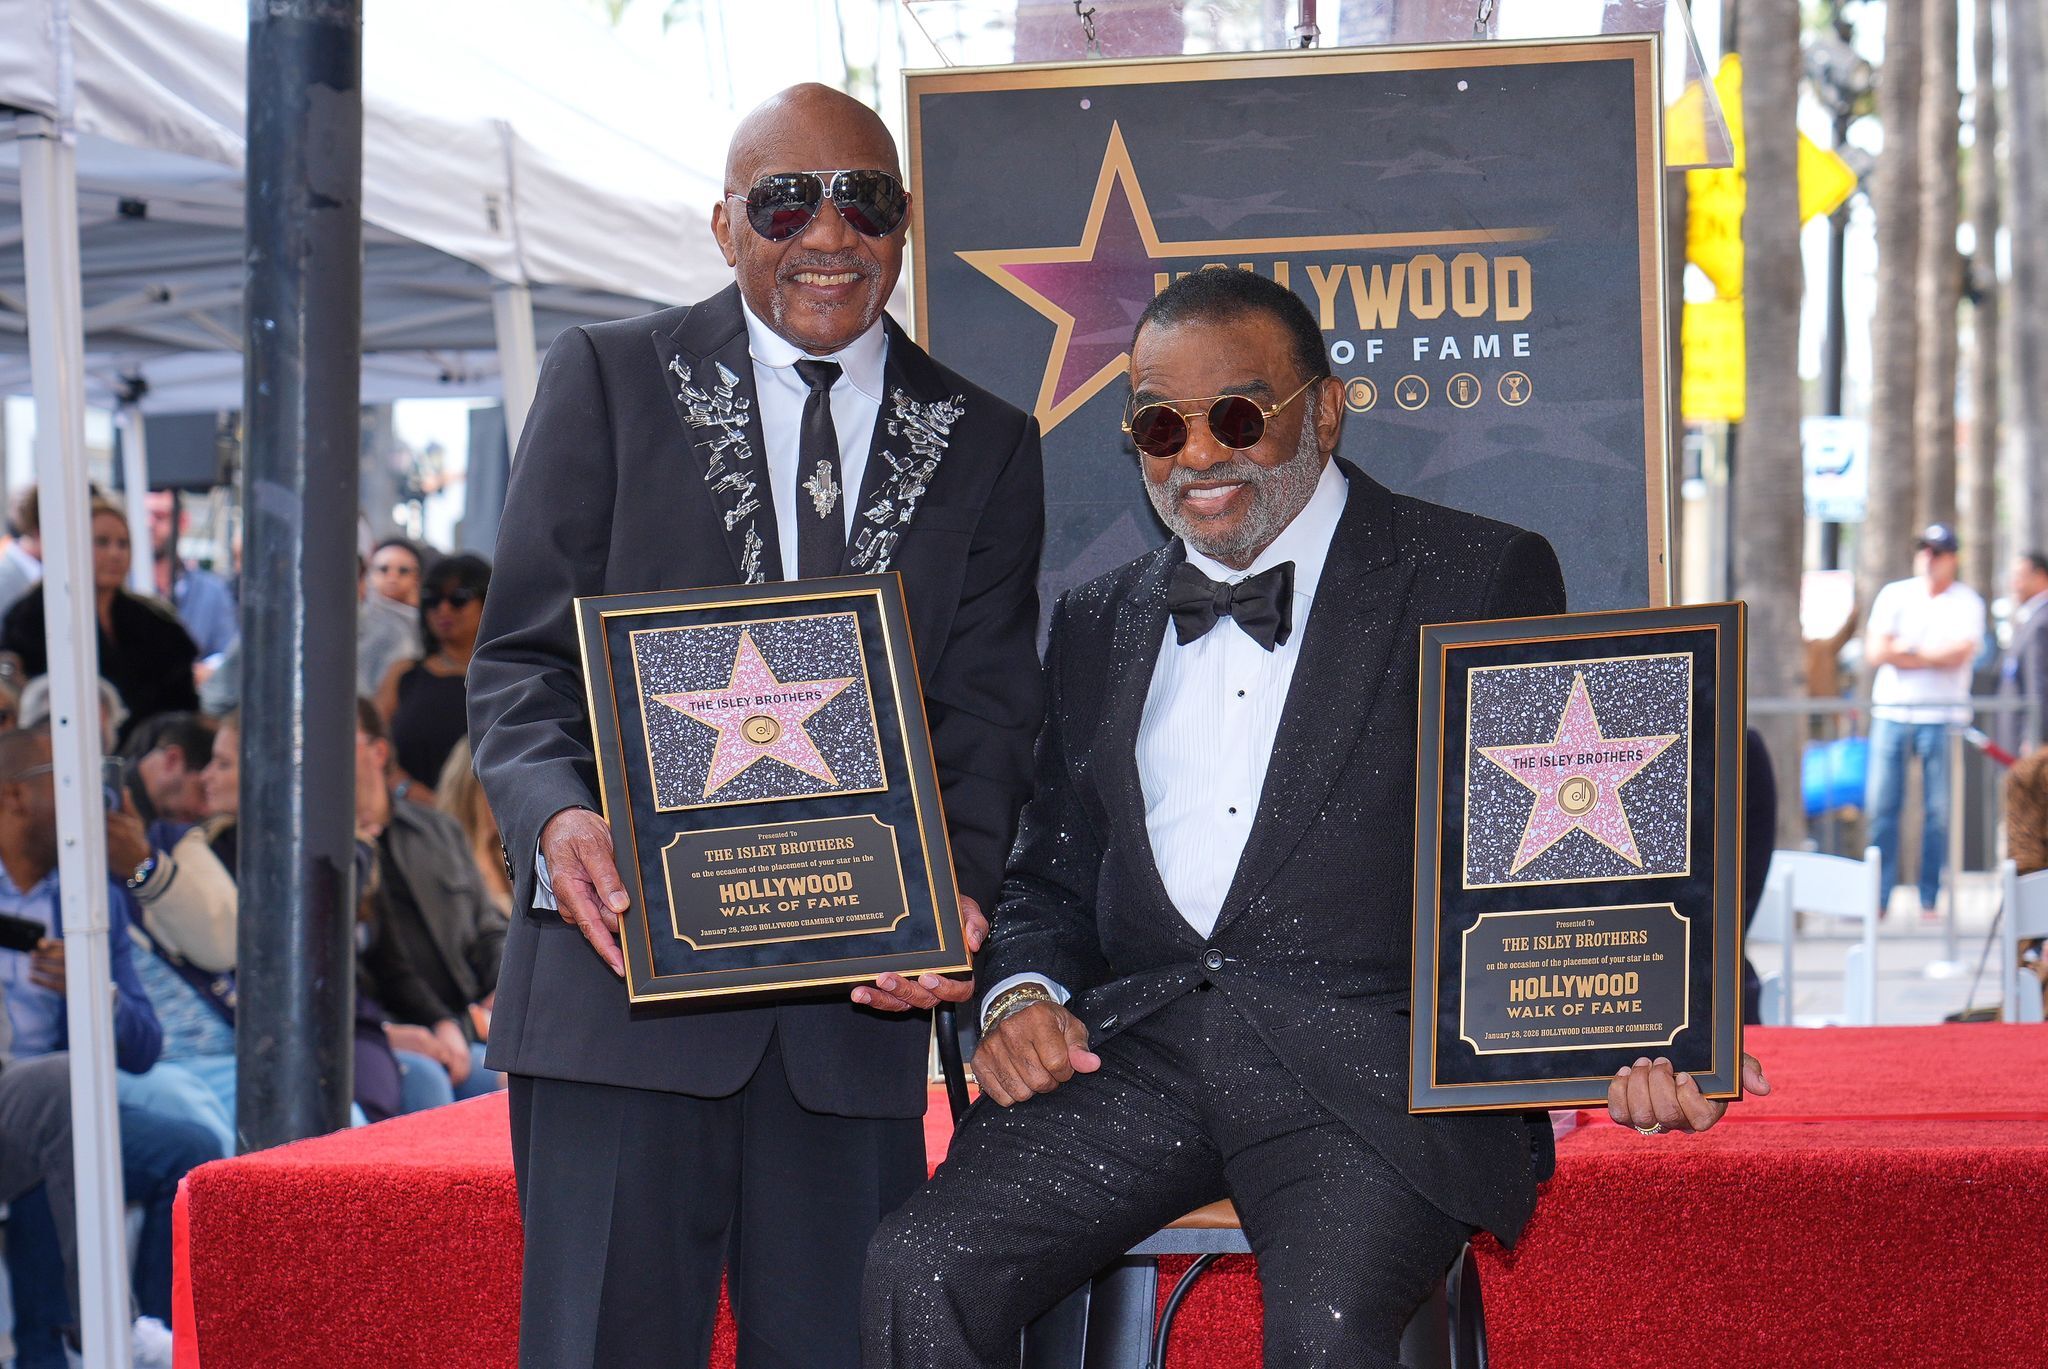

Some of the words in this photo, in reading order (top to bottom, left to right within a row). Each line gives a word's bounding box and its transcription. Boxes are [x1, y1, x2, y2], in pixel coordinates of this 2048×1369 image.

[1154, 252, 1532, 330] YWOOD
[1330, 339, 1383, 364] OF
[1413, 333, 1531, 361] FAME
[689, 701, 713, 711] THE
[718, 698, 751, 708] ISLEY
[755, 691, 822, 705] BROTHERS
[1513, 757, 1535, 769] THE
[1540, 755, 1573, 767] ISLEY
[1577, 749, 1643, 765] BROTHERS
[758, 832, 788, 840] Presented
[704, 849, 734, 862] THE
[736, 844, 778, 859] ISLEY
[781, 837, 854, 855] BROTHERS
[702, 869, 714, 877] the
[716, 866, 748, 876] occasion
[749, 864, 757, 872] of
[758, 864, 770, 872] the
[771, 861, 808, 872] placement
[810, 859, 817, 868] of
[818, 859, 834, 868] your
[836, 857, 852, 865] star
[862, 854, 874, 862] the
[719, 872, 852, 904] HOLLYWOOD
[719, 904, 772, 918] WALK
[778, 900, 800, 912] OF
[808, 894, 860, 909] FAME
[700, 928, 727, 936] January
[729, 926, 740, 934] 28,
[742, 924, 757, 932] 2026
[759, 920, 800, 931] HOLLYWOOD
[800, 916, 834, 927] CHAMBER
[846, 912, 884, 922] COMMERCE
[1556, 920, 1586, 929] Presented
[1503, 938, 1529, 952] THE
[1534, 934, 1572, 950] ISLEY
[1576, 930, 1648, 948] BROTHERS
[1486, 963, 1495, 971] on
[1496, 961, 1508, 970] the
[1509, 959, 1540, 969] occasion
[1542, 959, 1549, 967] of
[1550, 958, 1561, 967] the
[1563, 956, 1599, 968] placement
[1601, 956, 1608, 964] of
[1609, 956, 1625, 965] your
[1627, 954, 1642, 963] star
[1643, 953, 1650, 962] in
[1652, 953, 1664, 961] the
[1510, 971, 1639, 1002] HOLLYWOOD
[1507, 1005, 1556, 1019] WALK
[1562, 1003, 1585, 1016] OF
[1591, 1000, 1642, 1014] FAME
[1484, 1032, 1510, 1040] January
[1512, 1031, 1522, 1039] 28,
[1541, 1027, 1580, 1037] HOLLYWOOD
[1581, 1025, 1614, 1034] CHAMBER
[1616, 1024, 1624, 1032] OF
[1625, 1023, 1663, 1031] COMMERCE
